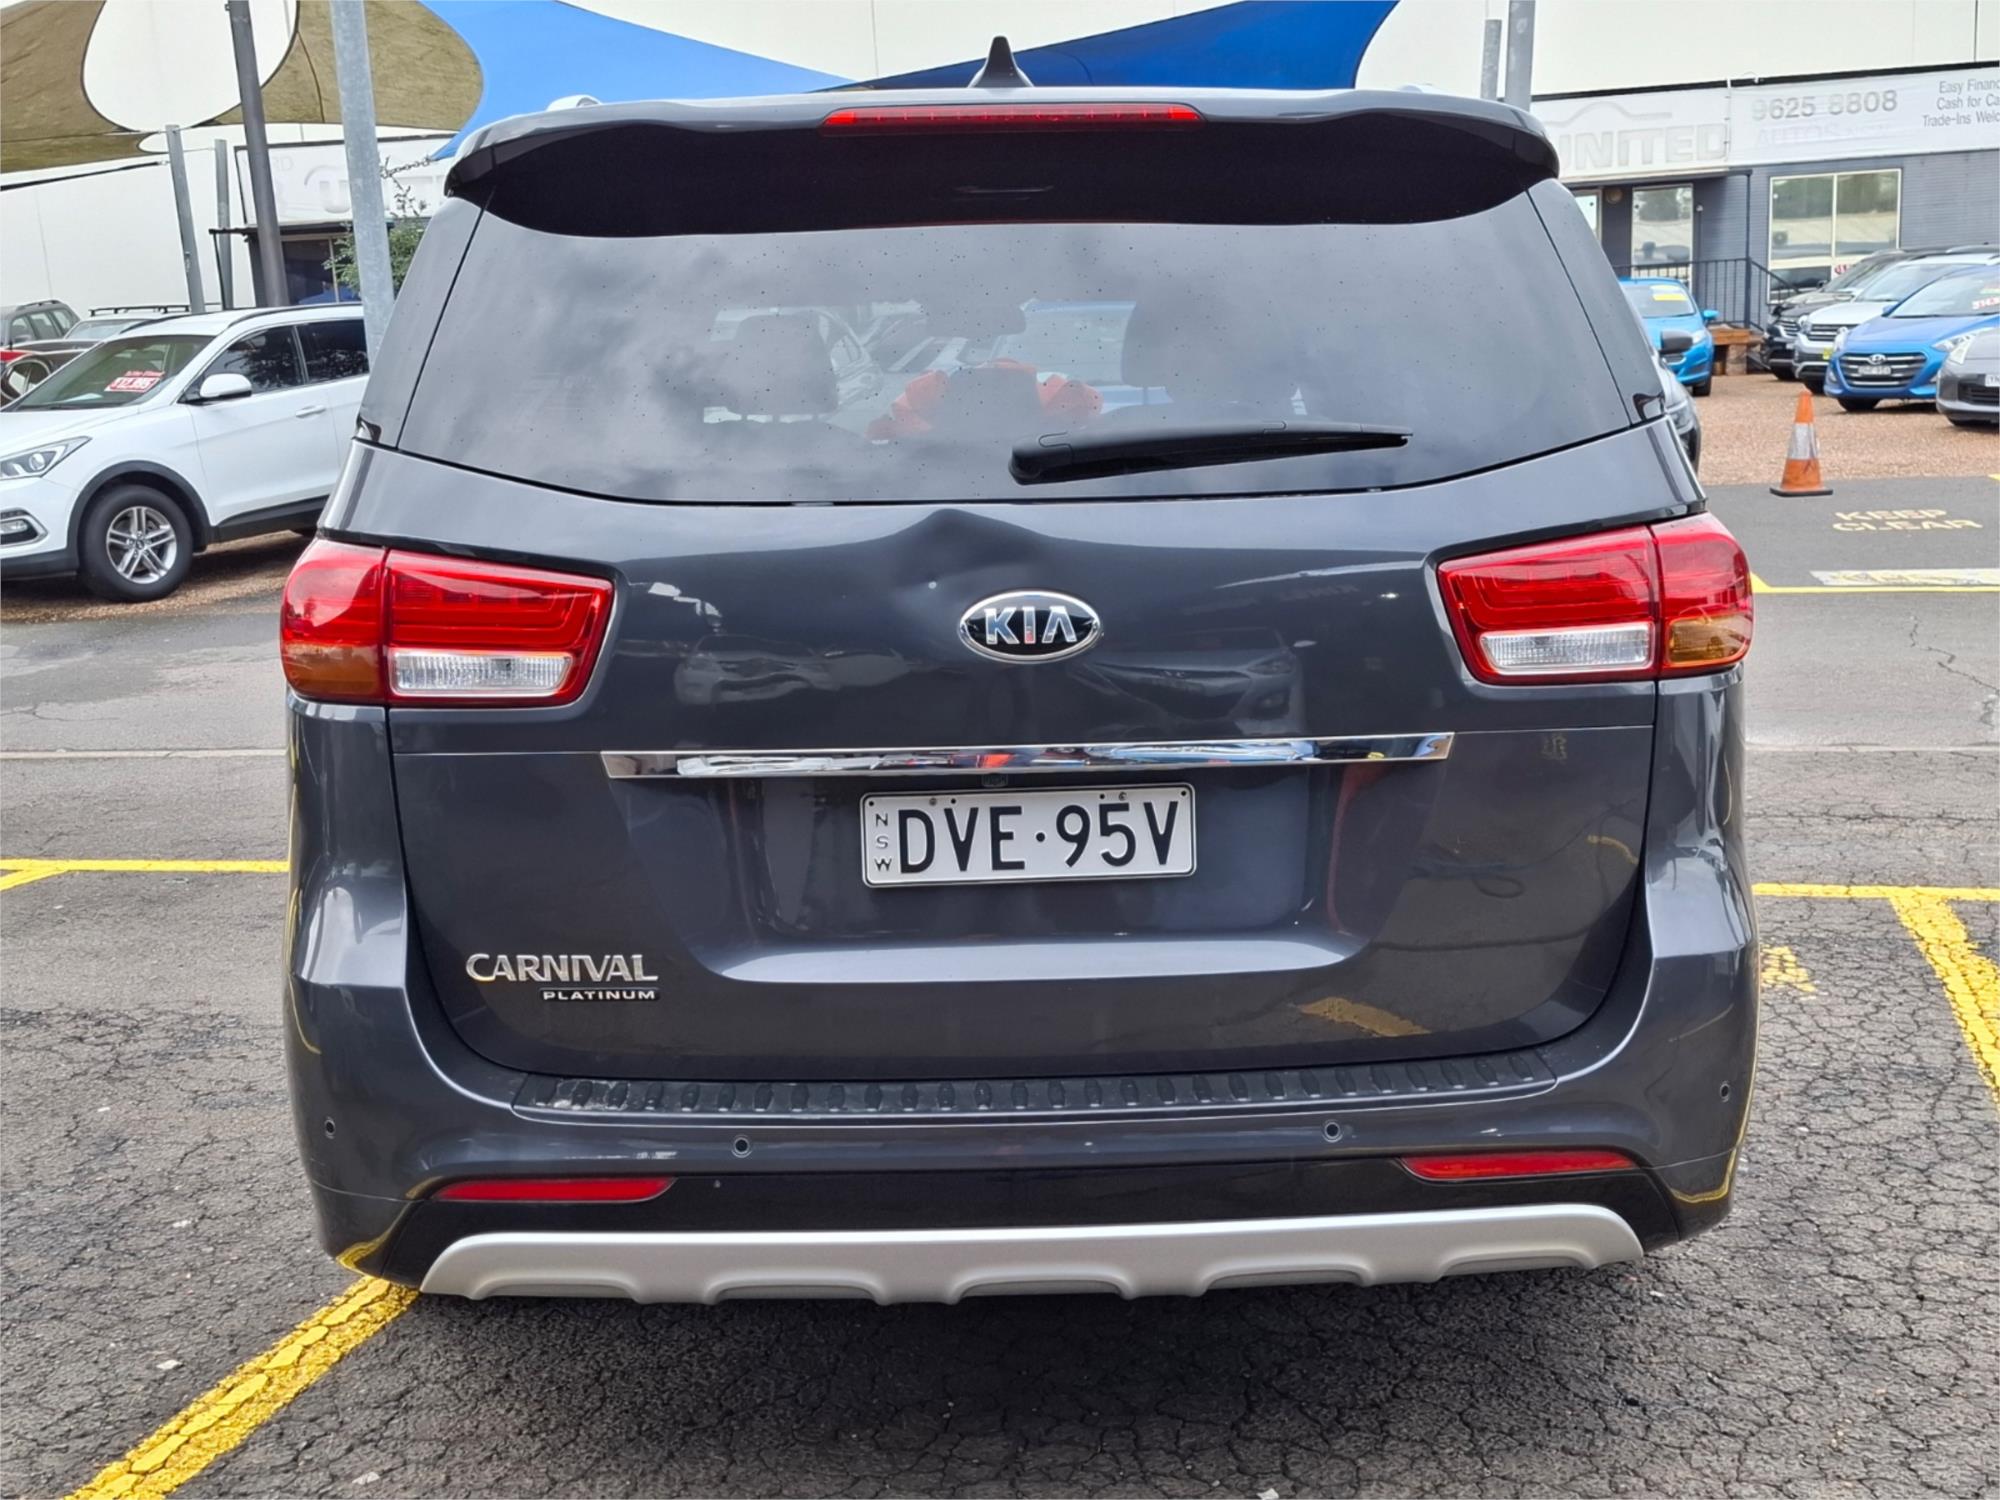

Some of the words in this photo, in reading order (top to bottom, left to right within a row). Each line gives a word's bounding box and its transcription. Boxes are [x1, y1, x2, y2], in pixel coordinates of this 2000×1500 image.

[1939, 80, 1965, 95] Easy
[1752, 96, 1816, 120] 9625
[1828, 90, 1898, 115] 8808
[1936, 96, 1964, 110] Cash
[1967, 95, 1982, 108] for
[1922, 112, 1972, 127] Trade-Ins
[1834, 508, 1948, 521] KEEP
[1832, 518, 1984, 532] CLEAR
[983, 606, 1078, 645] KIA
[465, 953, 660, 982] CARNIVAL
[542, 990, 656, 1001] PLATINUM
